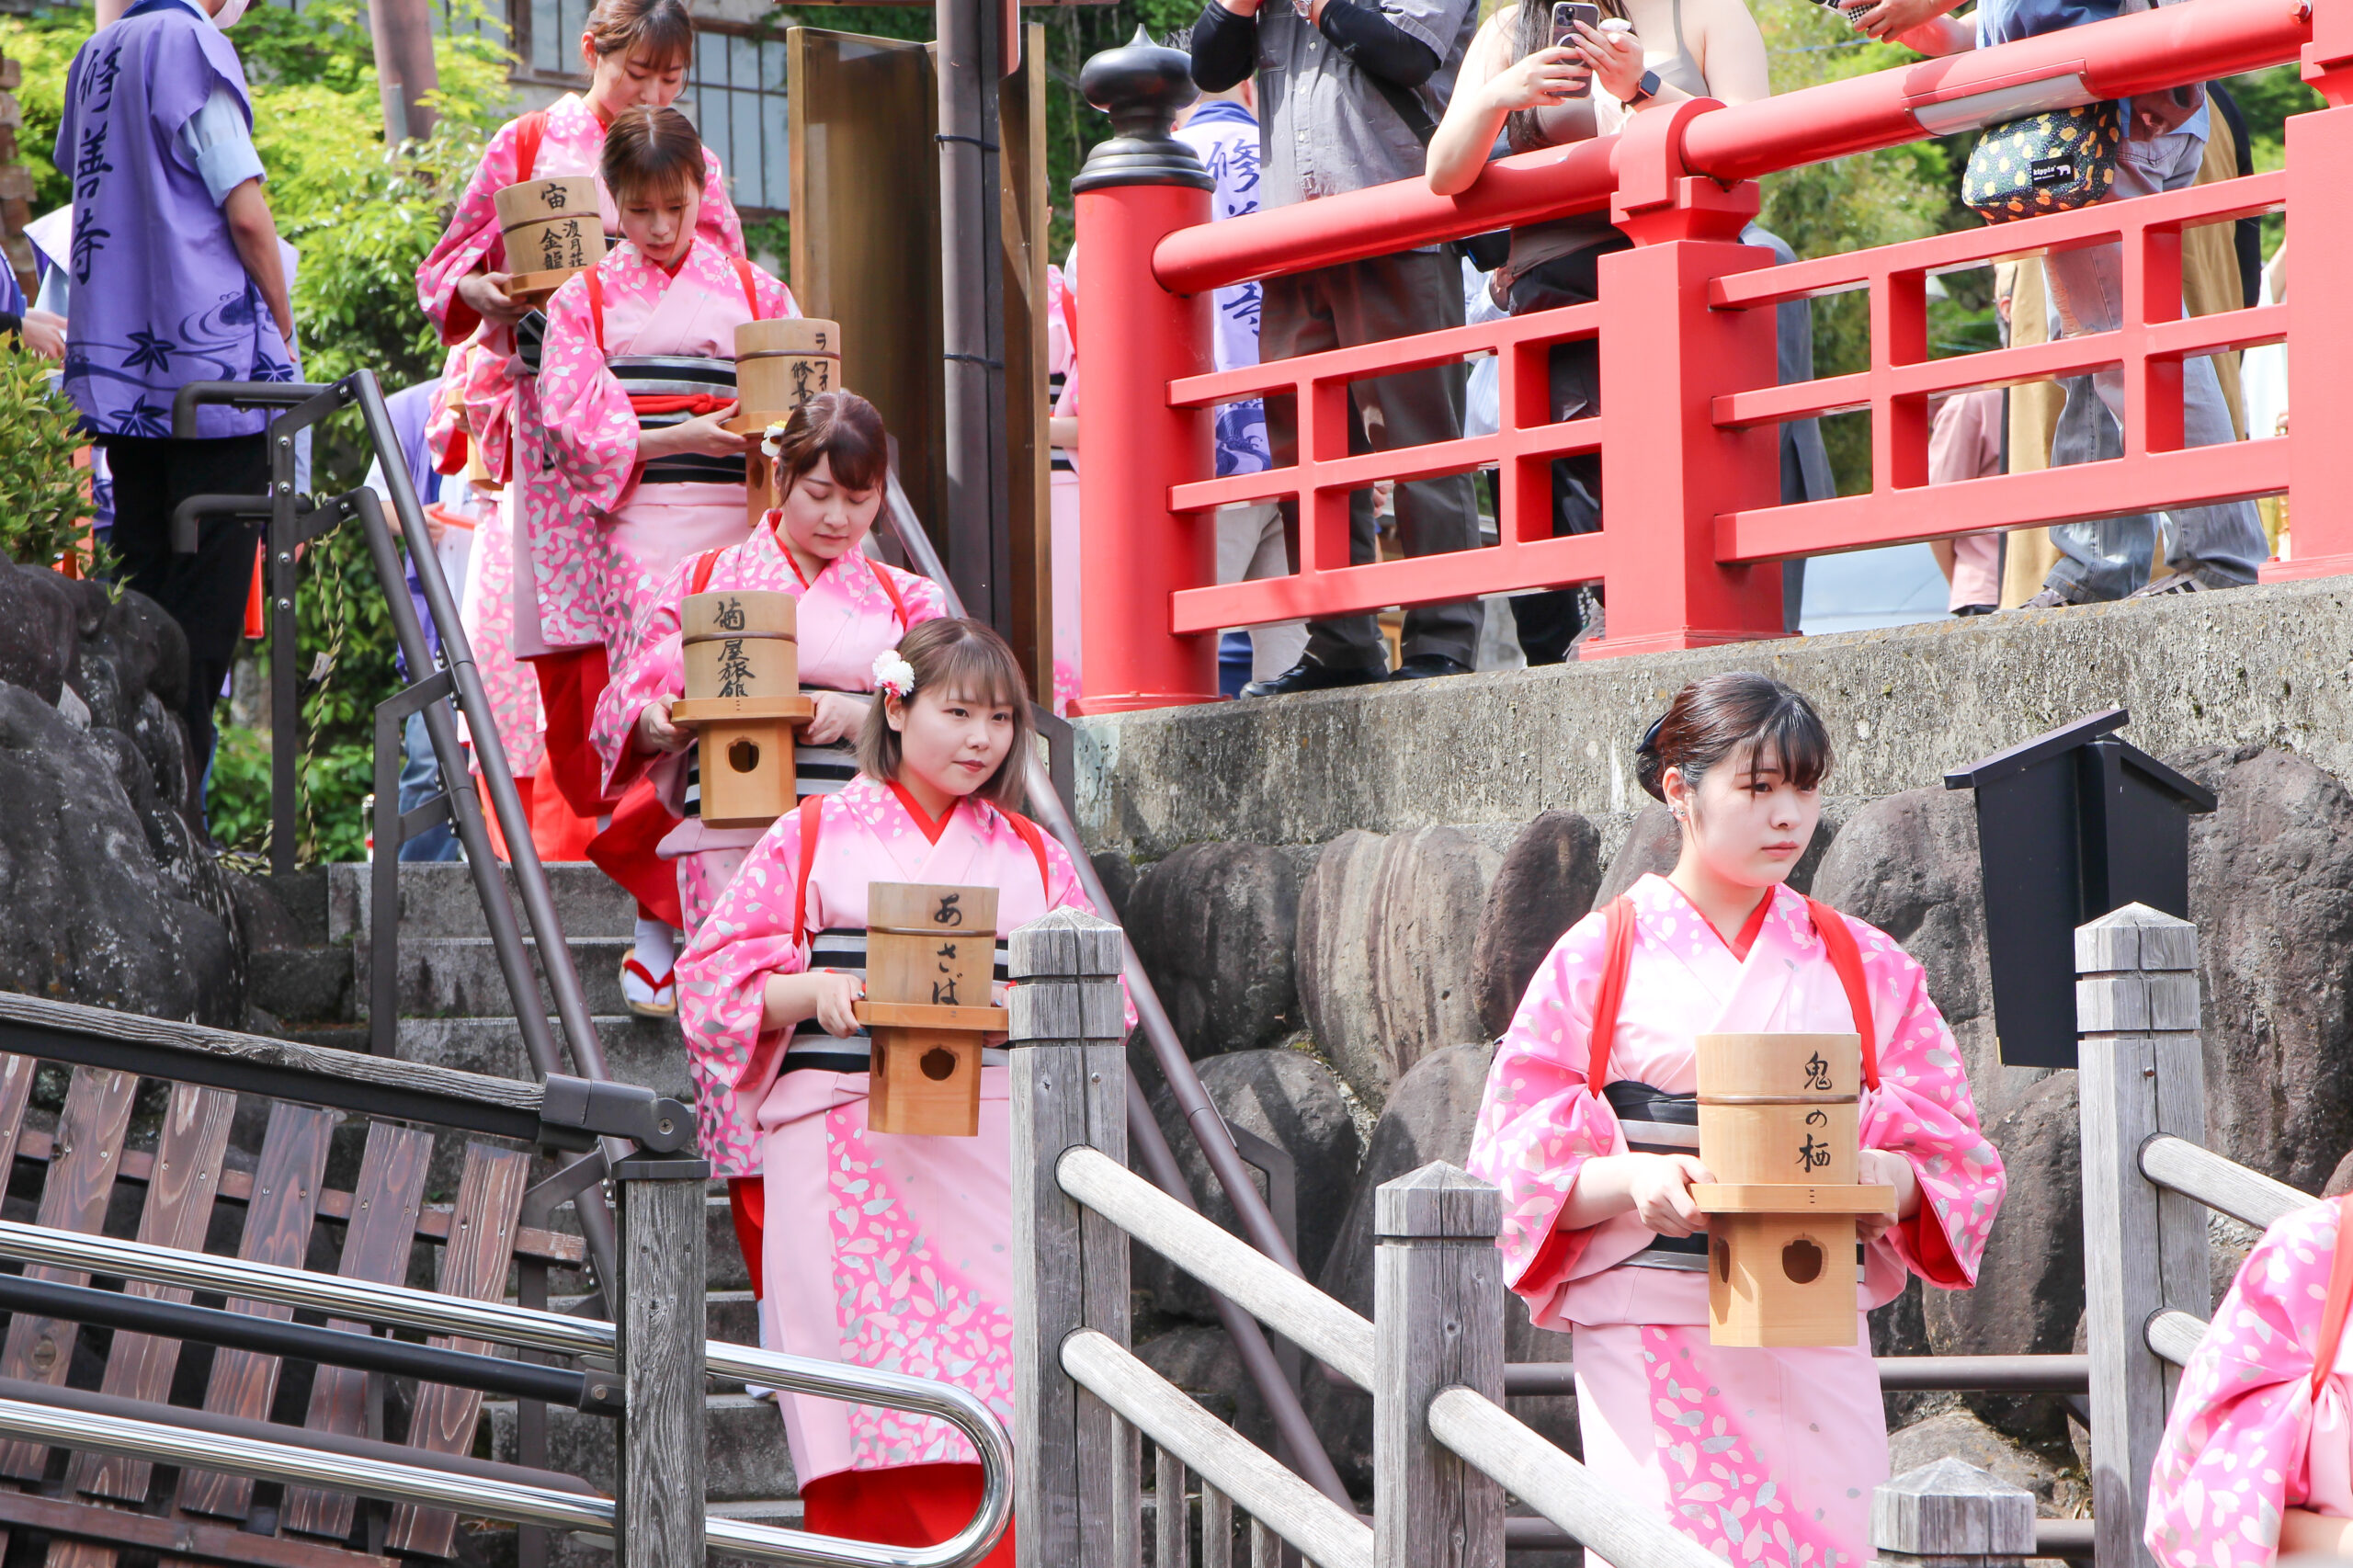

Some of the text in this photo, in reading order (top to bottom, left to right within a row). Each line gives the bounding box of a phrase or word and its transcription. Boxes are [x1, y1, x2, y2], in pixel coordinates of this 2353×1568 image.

[71, 46, 121, 285] 修善寺
[540, 183, 567, 210] 宙
[540, 227, 563, 270] 金龍
[563, 220, 587, 267] 渡月荘
[1206, 139, 1260, 336] 修寺
[932, 893, 962, 1006] あさば
[1795, 1051, 1833, 1173] 鬼の栖
